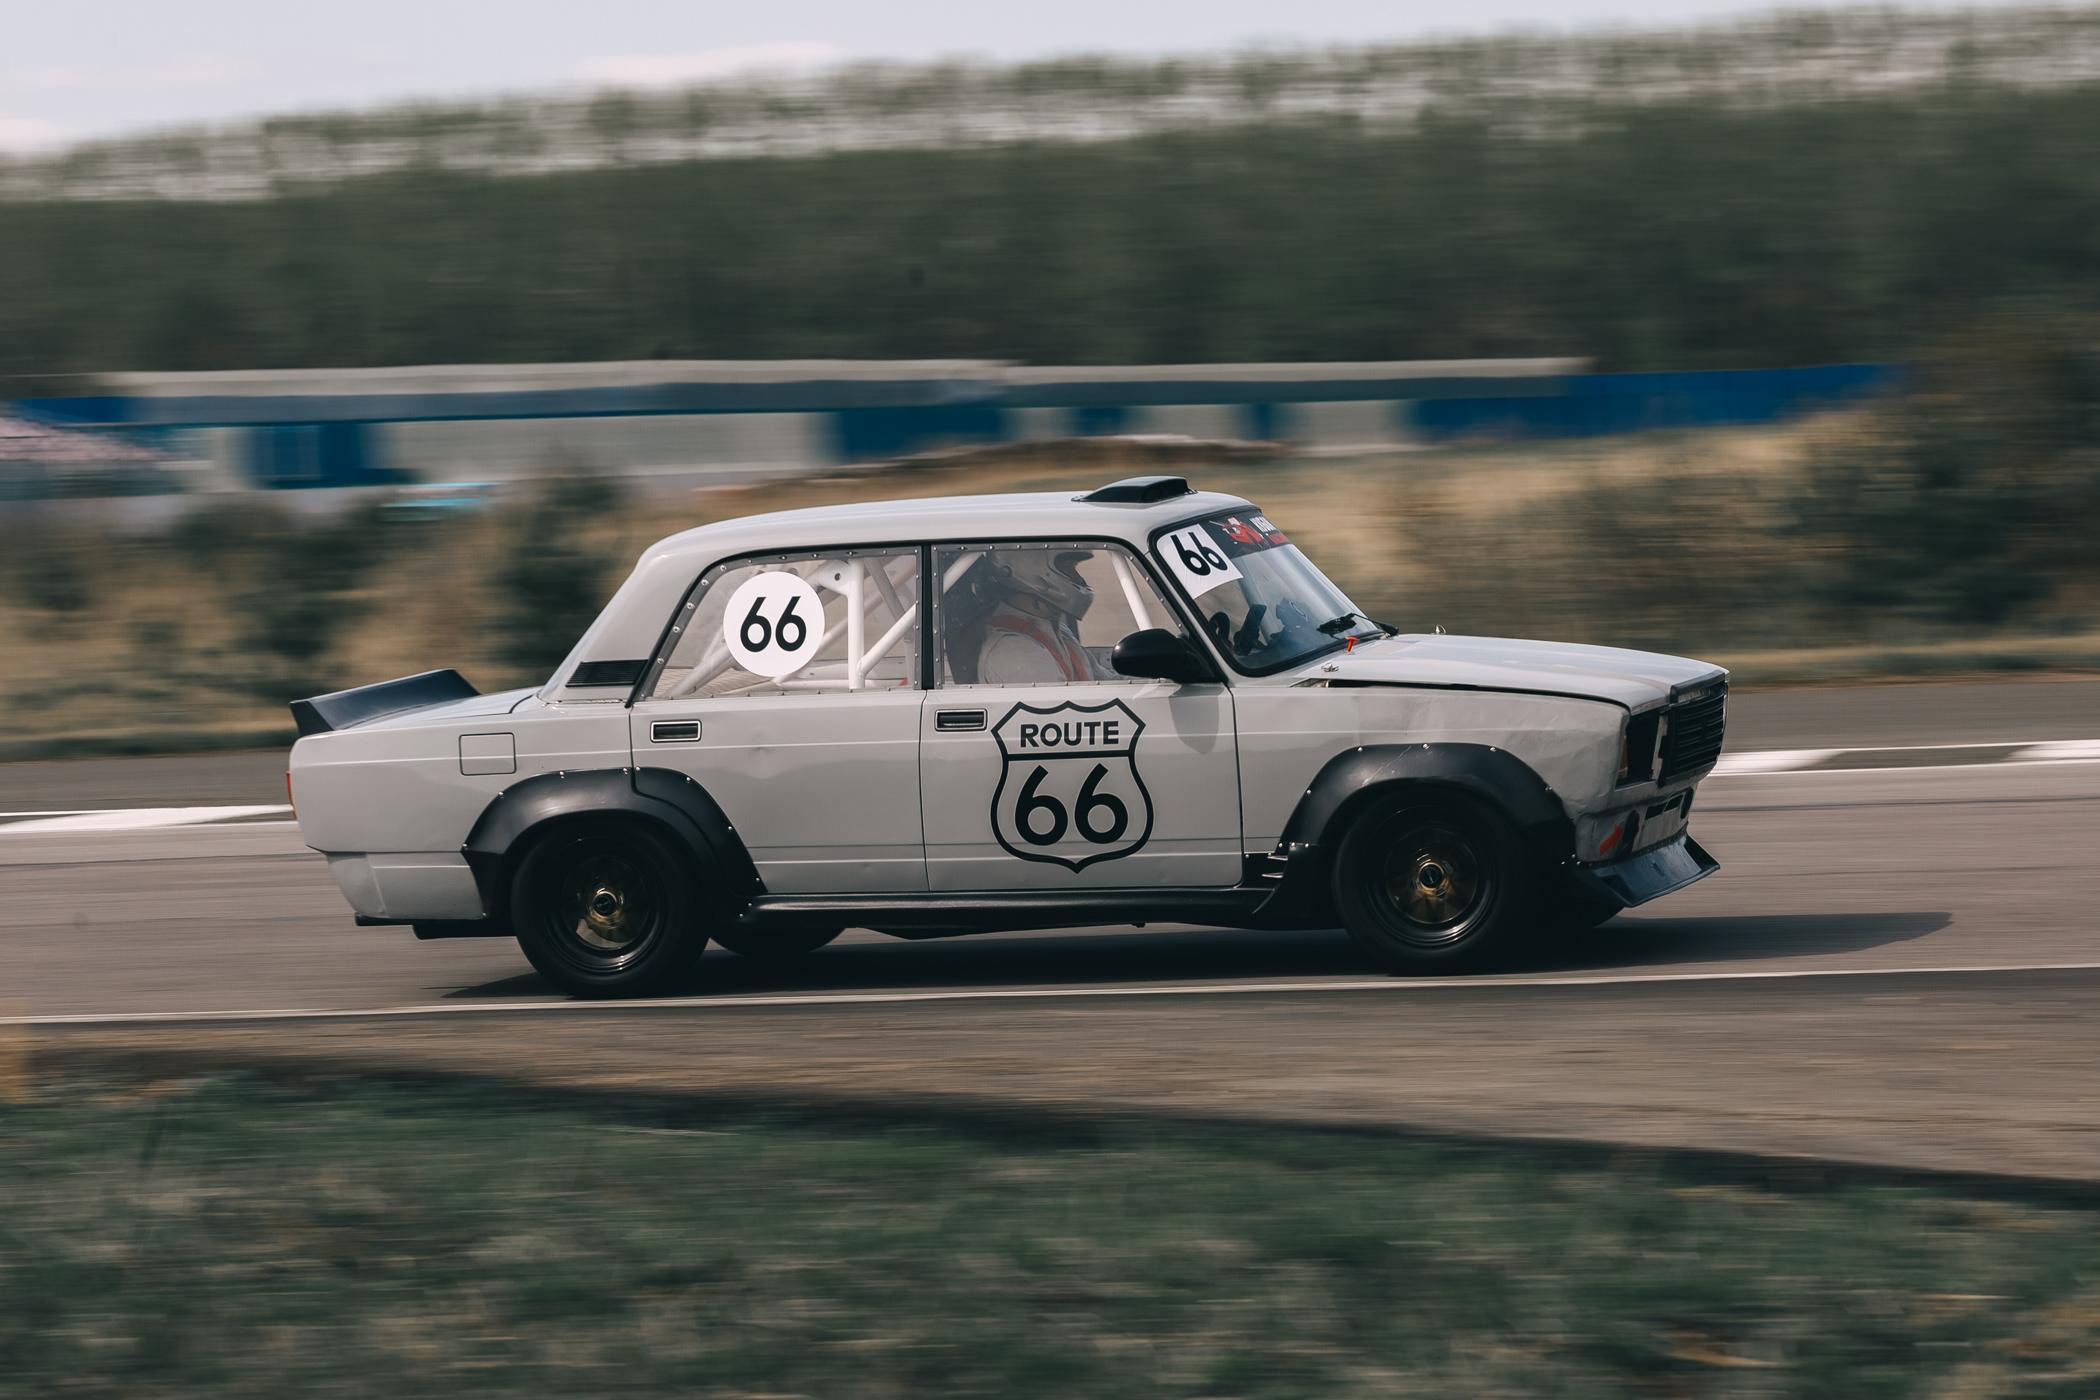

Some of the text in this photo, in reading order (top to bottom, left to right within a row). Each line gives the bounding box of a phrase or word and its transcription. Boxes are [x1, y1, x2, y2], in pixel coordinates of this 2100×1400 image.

[1170, 531, 1228, 576] 66
[740, 596, 807, 653] 66
[1020, 721, 1119, 748] ROUTE
[1015, 763, 1129, 846] 66
